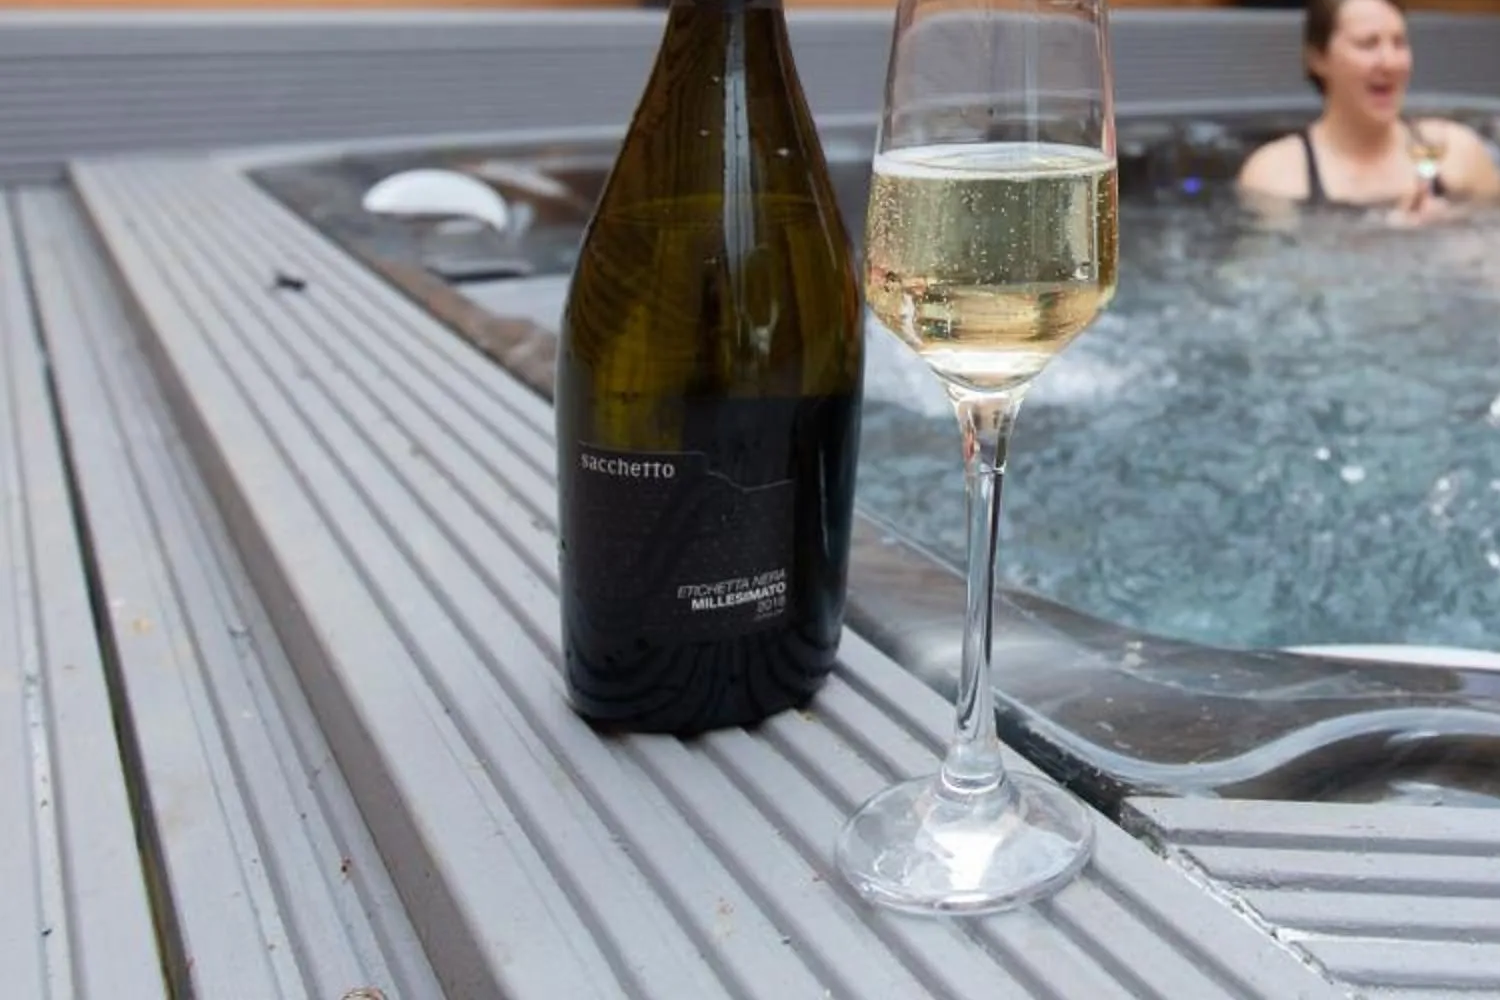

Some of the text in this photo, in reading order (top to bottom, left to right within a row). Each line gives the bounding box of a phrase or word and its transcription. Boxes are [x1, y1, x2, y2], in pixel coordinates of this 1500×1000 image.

[580, 453, 676, 479] sacchetto
[677, 577, 749, 599] ETICHETTA
[691, 582, 787, 610] MILLESIMATO
